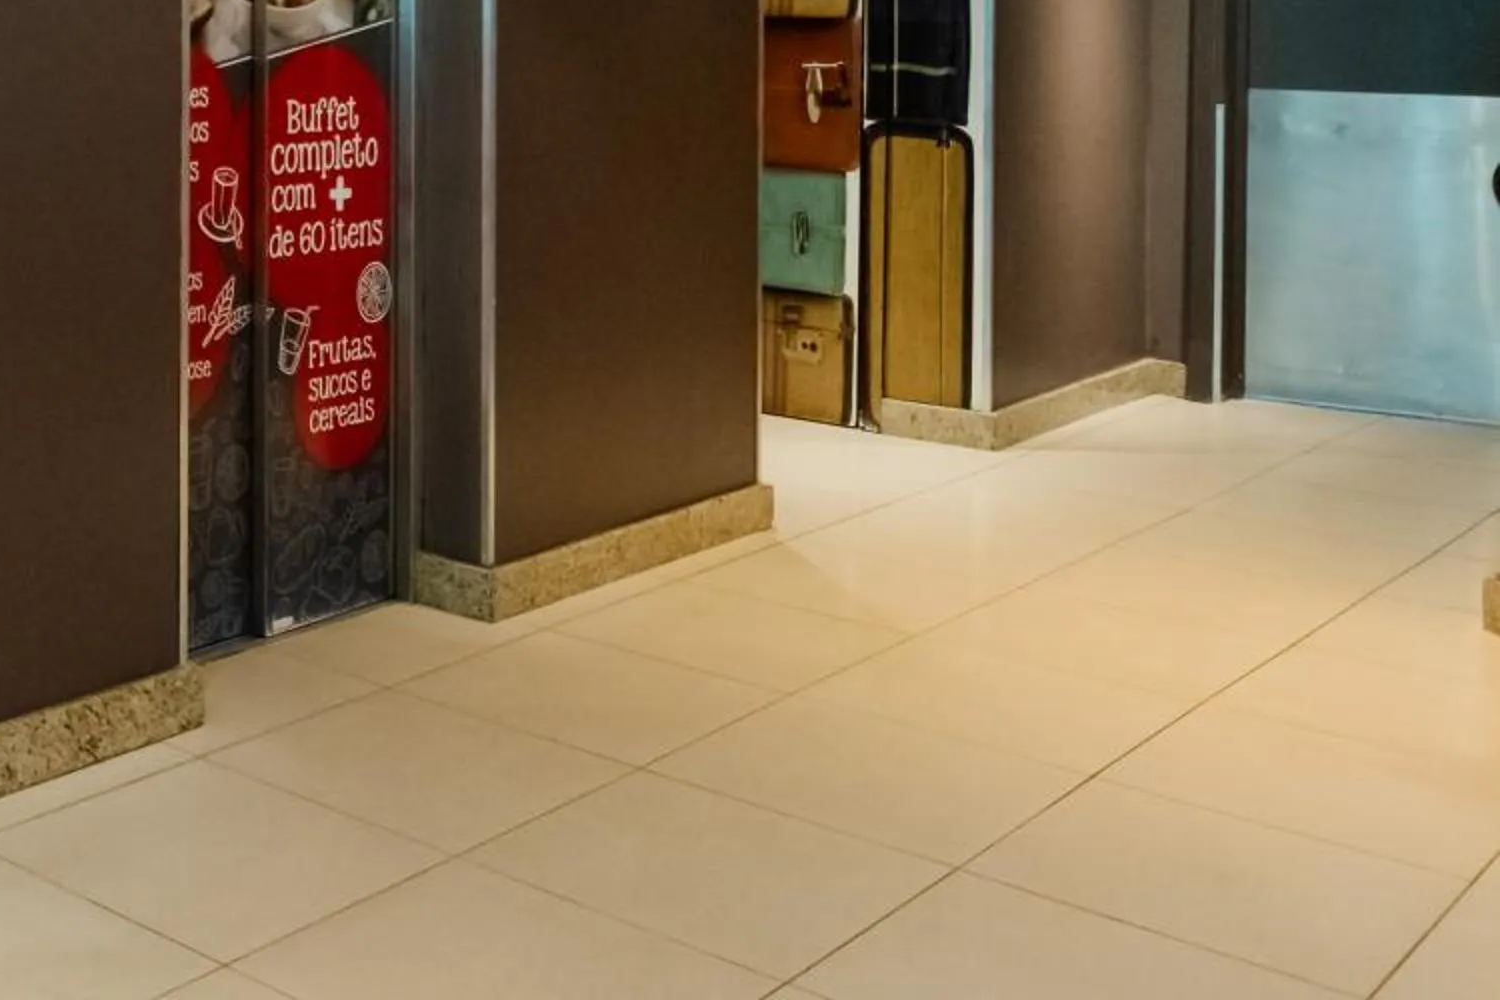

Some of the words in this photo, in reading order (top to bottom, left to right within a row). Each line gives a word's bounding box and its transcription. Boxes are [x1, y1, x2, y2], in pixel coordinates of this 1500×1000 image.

[286, 95, 360, 135] Buffet
[270, 131, 379, 181] completo
[271, 182, 317, 213] com
[268, 224, 295, 259] de
[299, 220, 326, 255] 60
[308, 369, 358, 403] sucos
[361, 367, 372, 391] e
[309, 395, 375, 434] cereais
